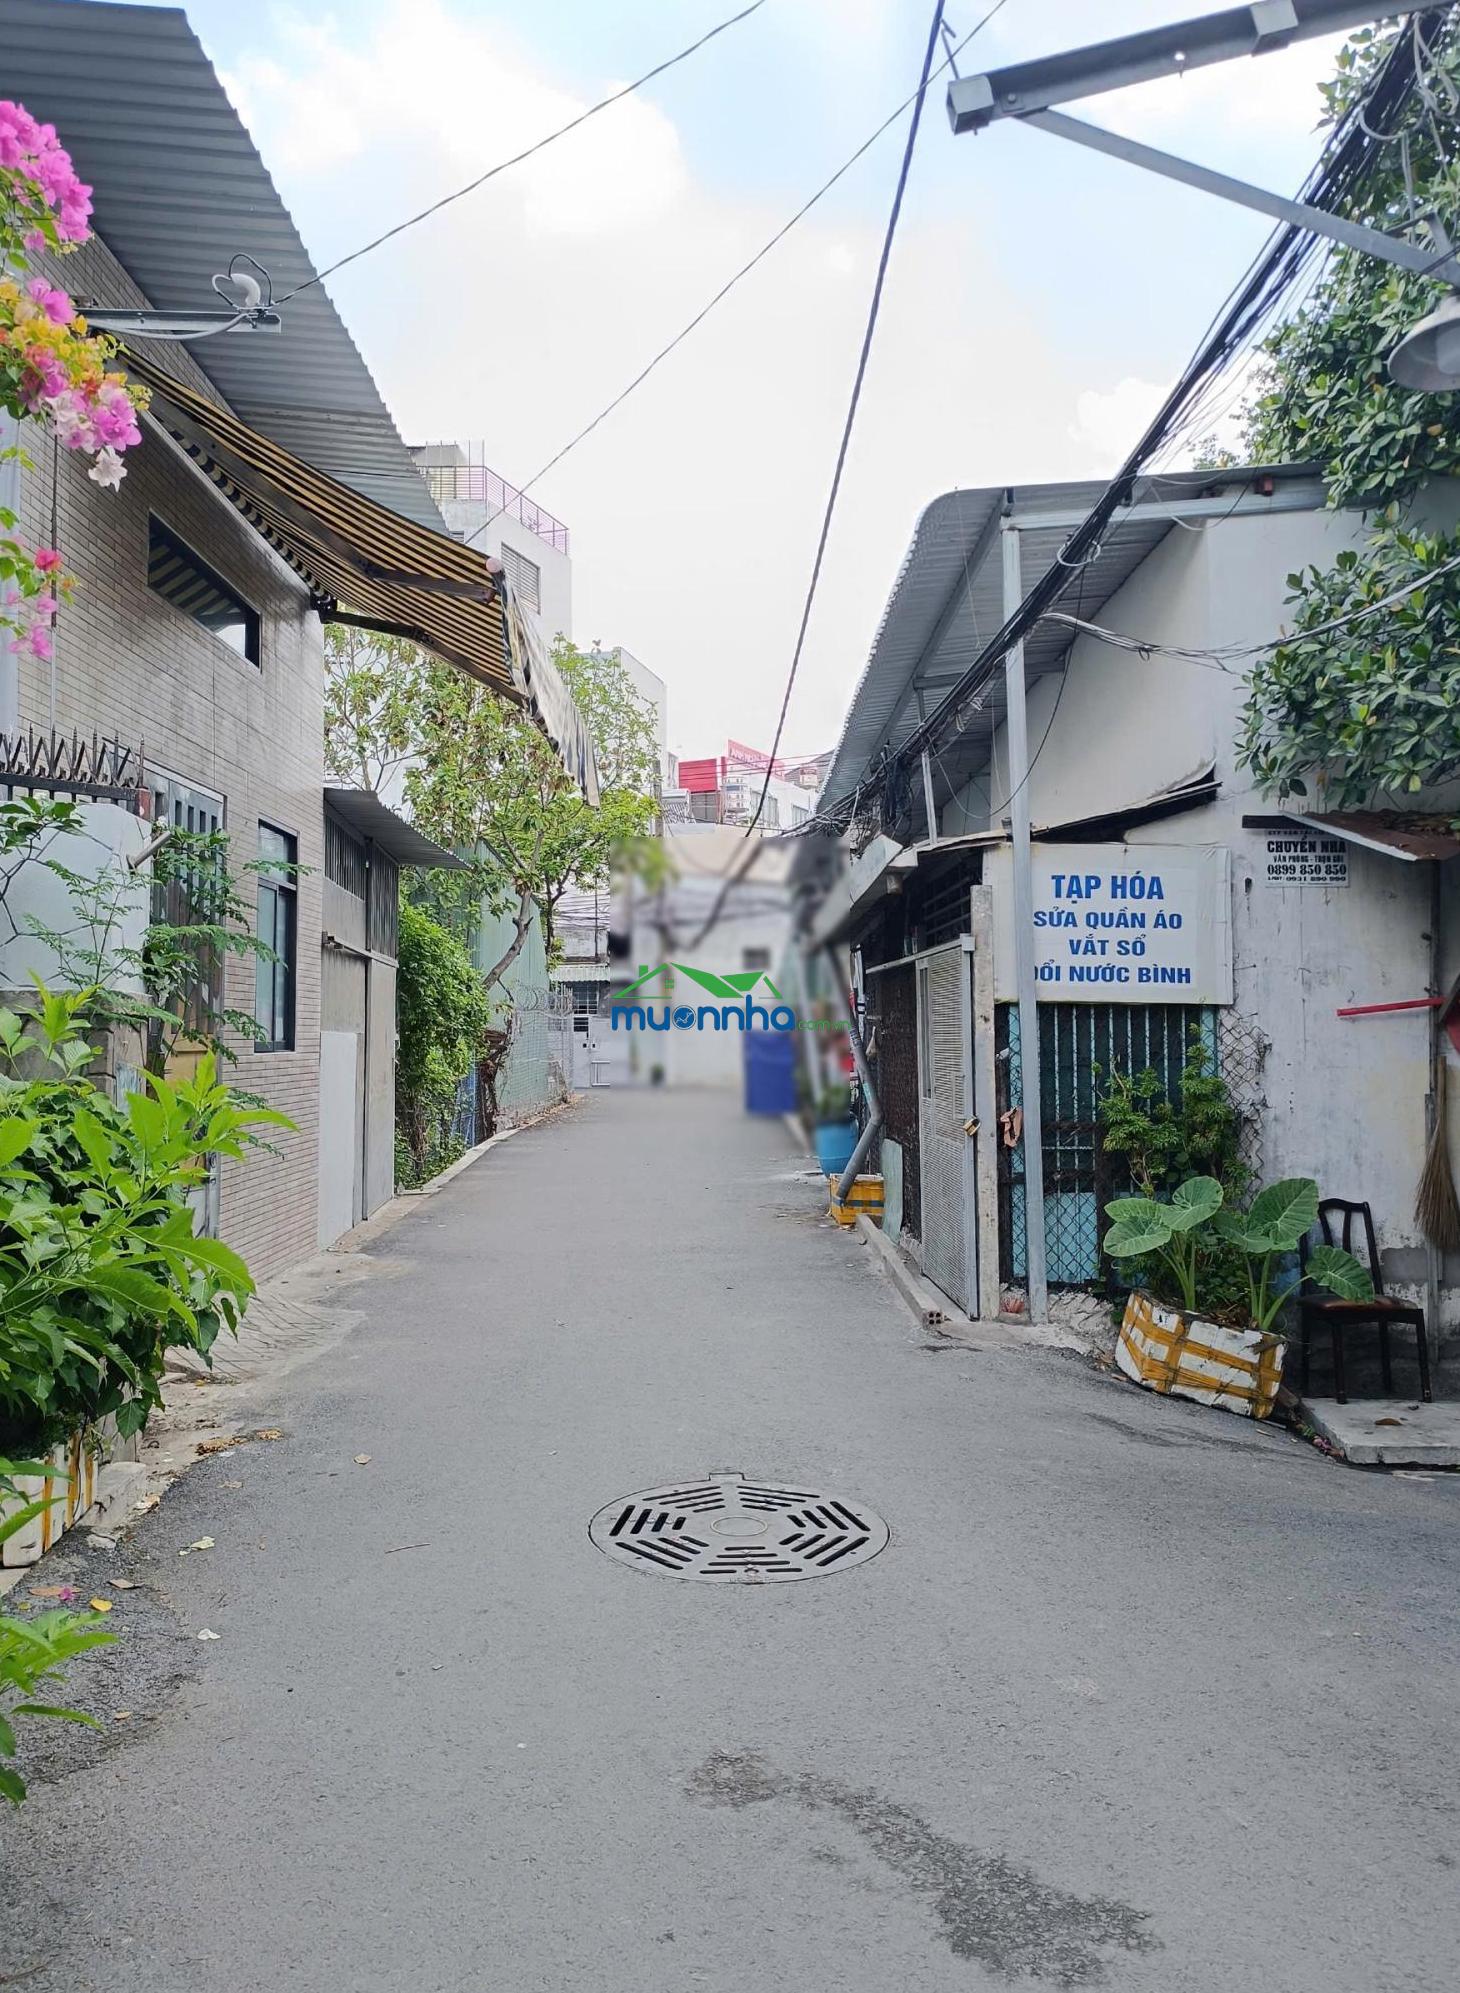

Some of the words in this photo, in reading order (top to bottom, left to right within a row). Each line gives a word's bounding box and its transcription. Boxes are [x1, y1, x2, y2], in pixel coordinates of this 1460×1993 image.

[1267, 834, 1317, 853] CHUYỂN
[1267, 864, 1296, 875] 0899
[1300, 864, 1321, 875] 850
[1325, 864, 1347, 875] 850
[1051, 874, 1102, 904] TẠP
[1111, 871, 1164, 900] HÓA
[1033, 906, 1078, 928] SỬA
[1085, 906, 1146, 930] QUẦN
[1153, 909, 1183, 929] ÁO
[1068, 934, 1110, 956] VẮT
[1116, 933, 1147, 956] SỔ
[1034, 959, 1061, 982] ỔI
[1069, 963, 1130, 983] NƯỚC
[1137, 963, 1191, 984] BÌNH
